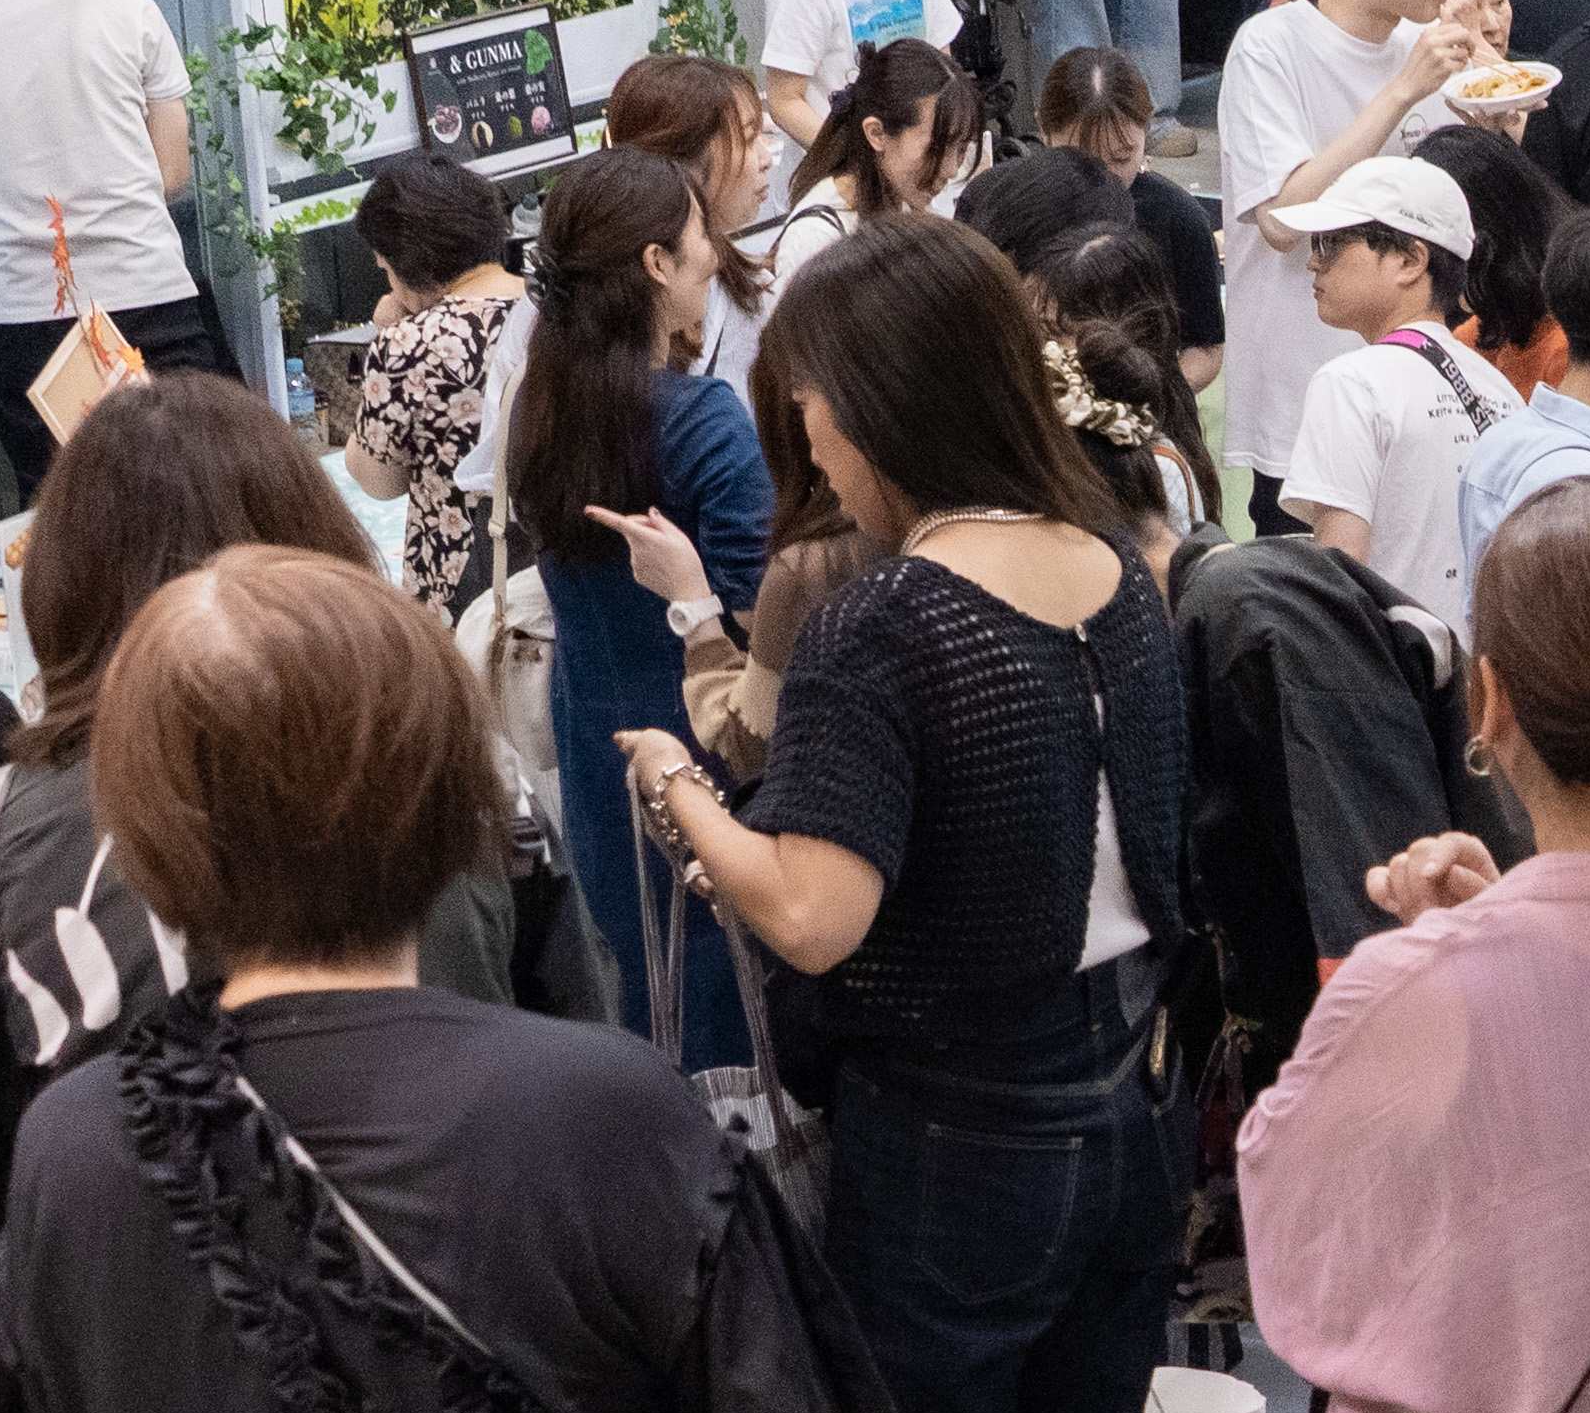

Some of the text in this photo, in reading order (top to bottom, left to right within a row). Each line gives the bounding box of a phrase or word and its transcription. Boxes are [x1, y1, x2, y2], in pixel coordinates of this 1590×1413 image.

[450, 40, 523, 74] & GUNMA
[1438, 356, 1475, 406] 1988
